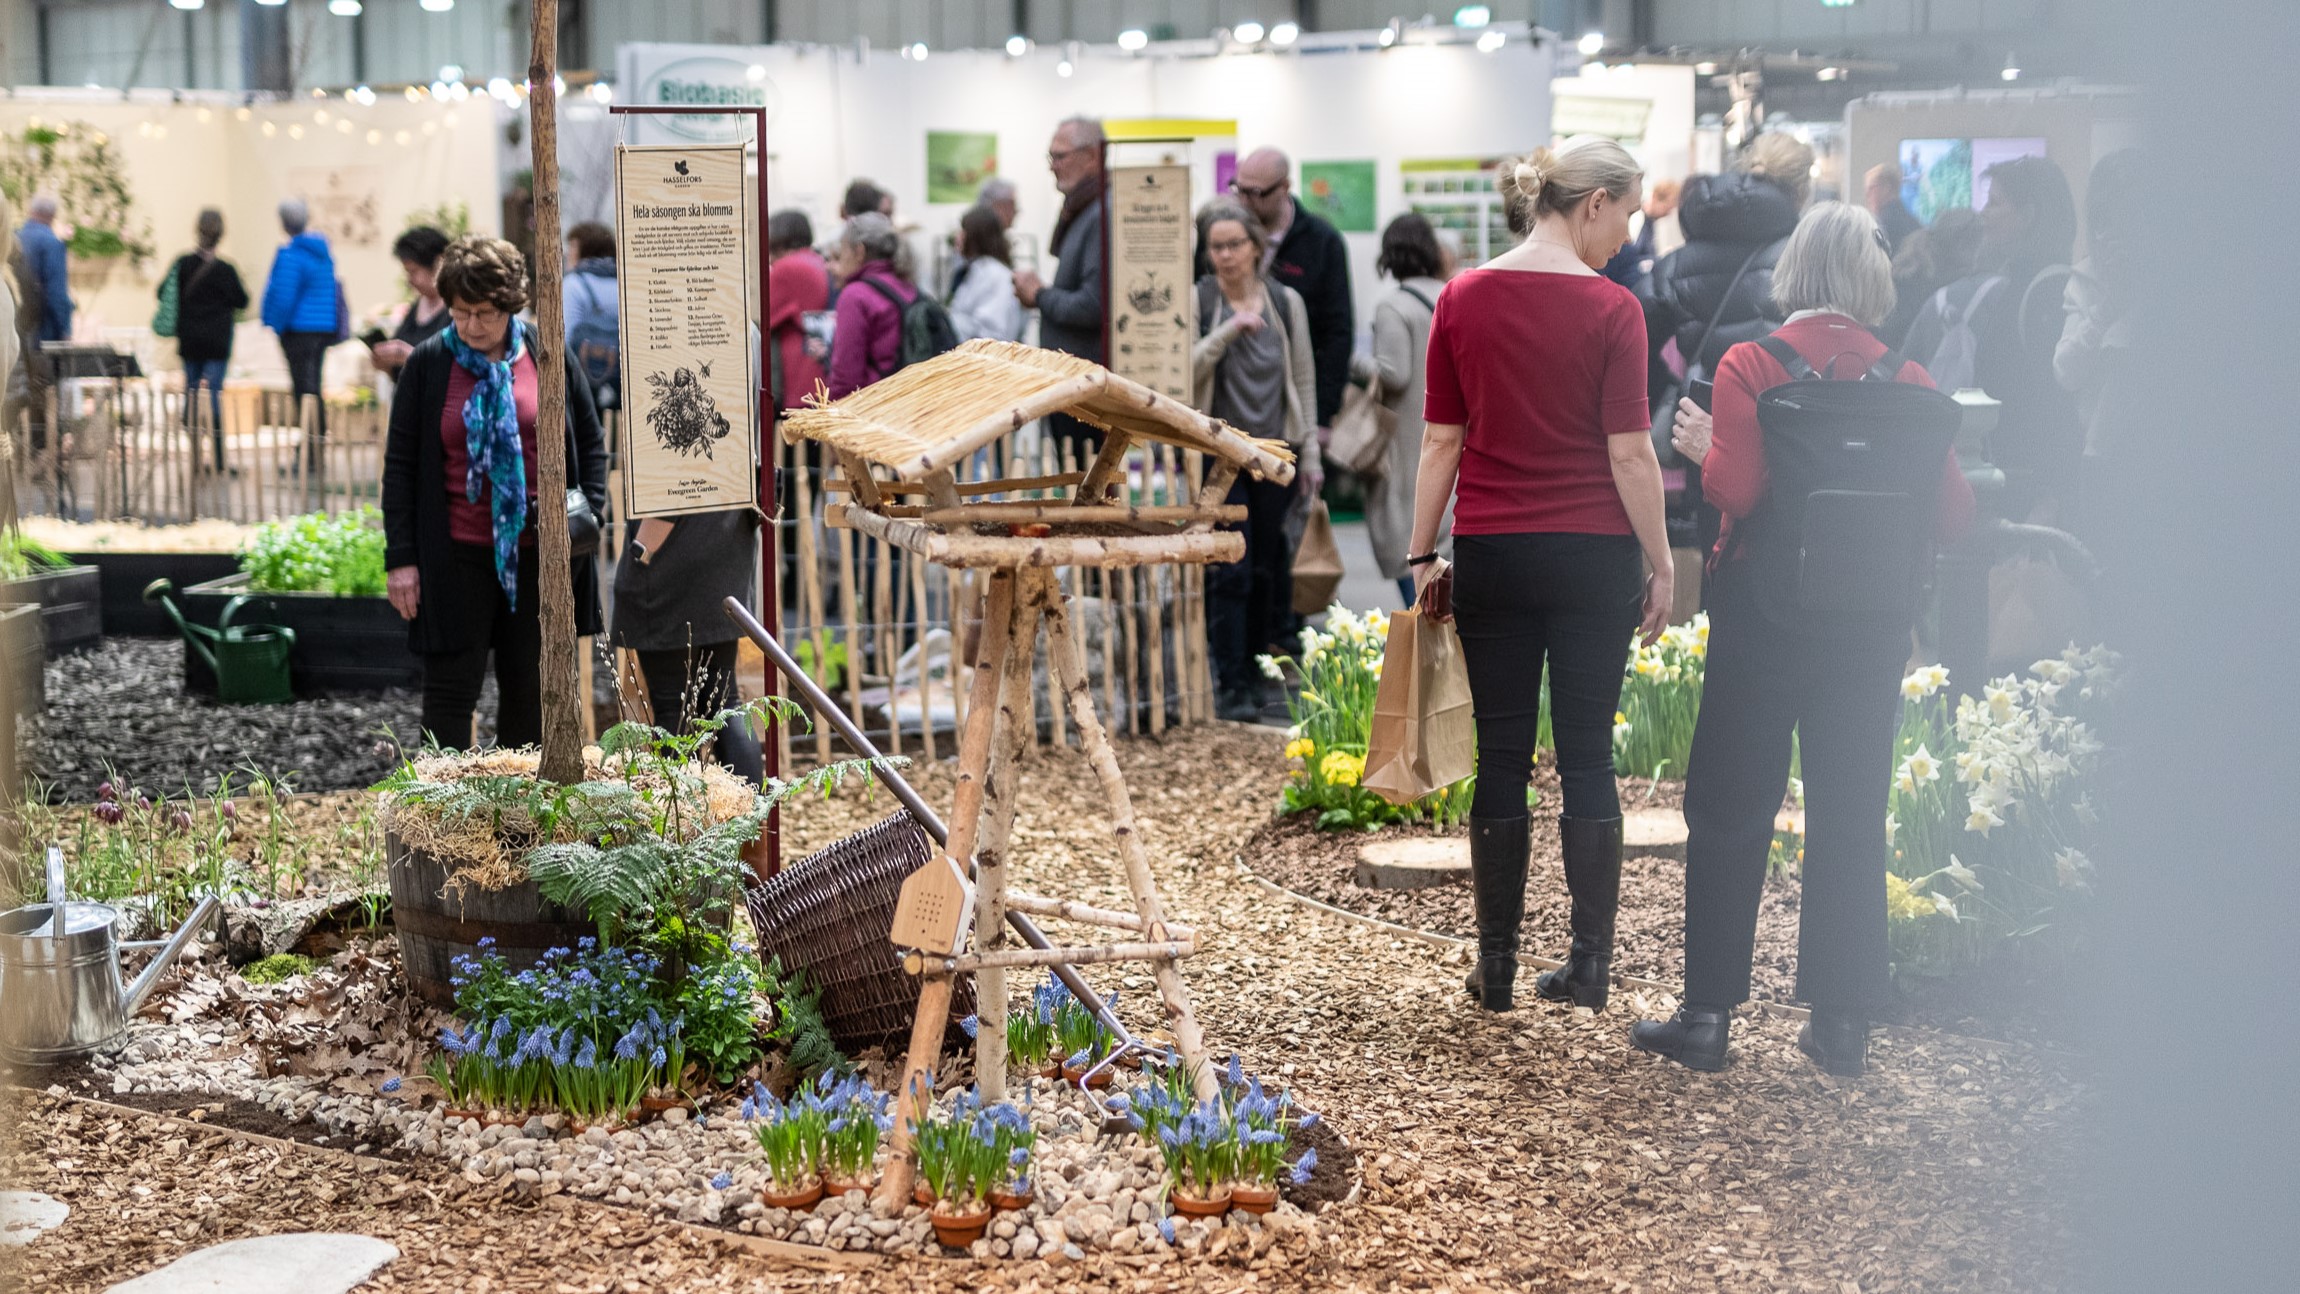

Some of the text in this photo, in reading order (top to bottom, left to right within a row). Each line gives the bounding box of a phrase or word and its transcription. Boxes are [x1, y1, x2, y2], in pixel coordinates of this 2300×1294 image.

[633, 202, 732, 220] Hela säsongen ska blomma
[668, 487, 695, 496] Evergreen
